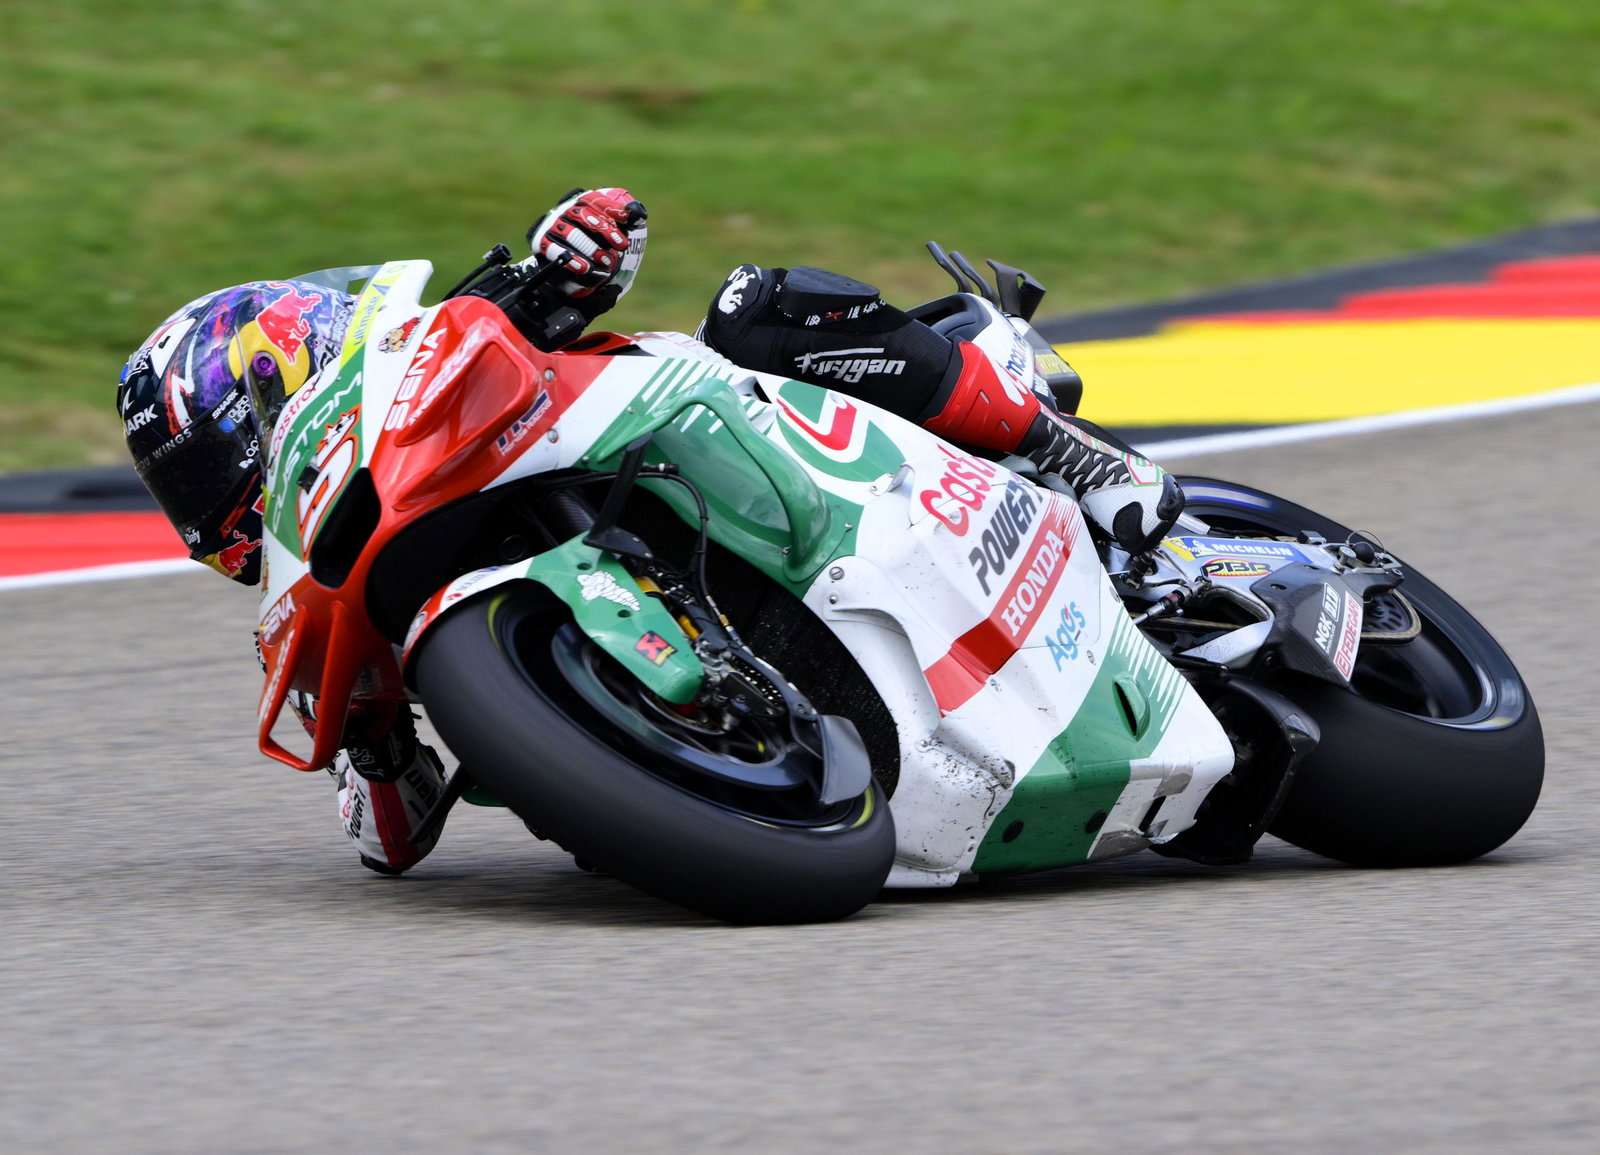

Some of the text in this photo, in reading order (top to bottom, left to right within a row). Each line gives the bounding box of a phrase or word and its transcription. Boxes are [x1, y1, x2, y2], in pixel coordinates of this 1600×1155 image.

[384, 327, 448, 431] SENA
[793, 347, 907, 384] Furygan
[124, 403, 159, 437] ARK
[211, 388, 239, 420] SHARK
[228, 394, 249, 419] QUAD
[234, 402, 251, 424] LOC
[151, 427, 193, 461] WINGS
[272, 370, 363, 535] CUSTOM
[1211, 543, 1294, 557] MICHELIN
[1000, 530, 1066, 638] HONDA
[1201, 561, 1274, 578] PBR
[262, 592, 297, 643] SENA
[1314, 611, 1333, 651] NGK
[1044, 600, 1086, 673] Agos
